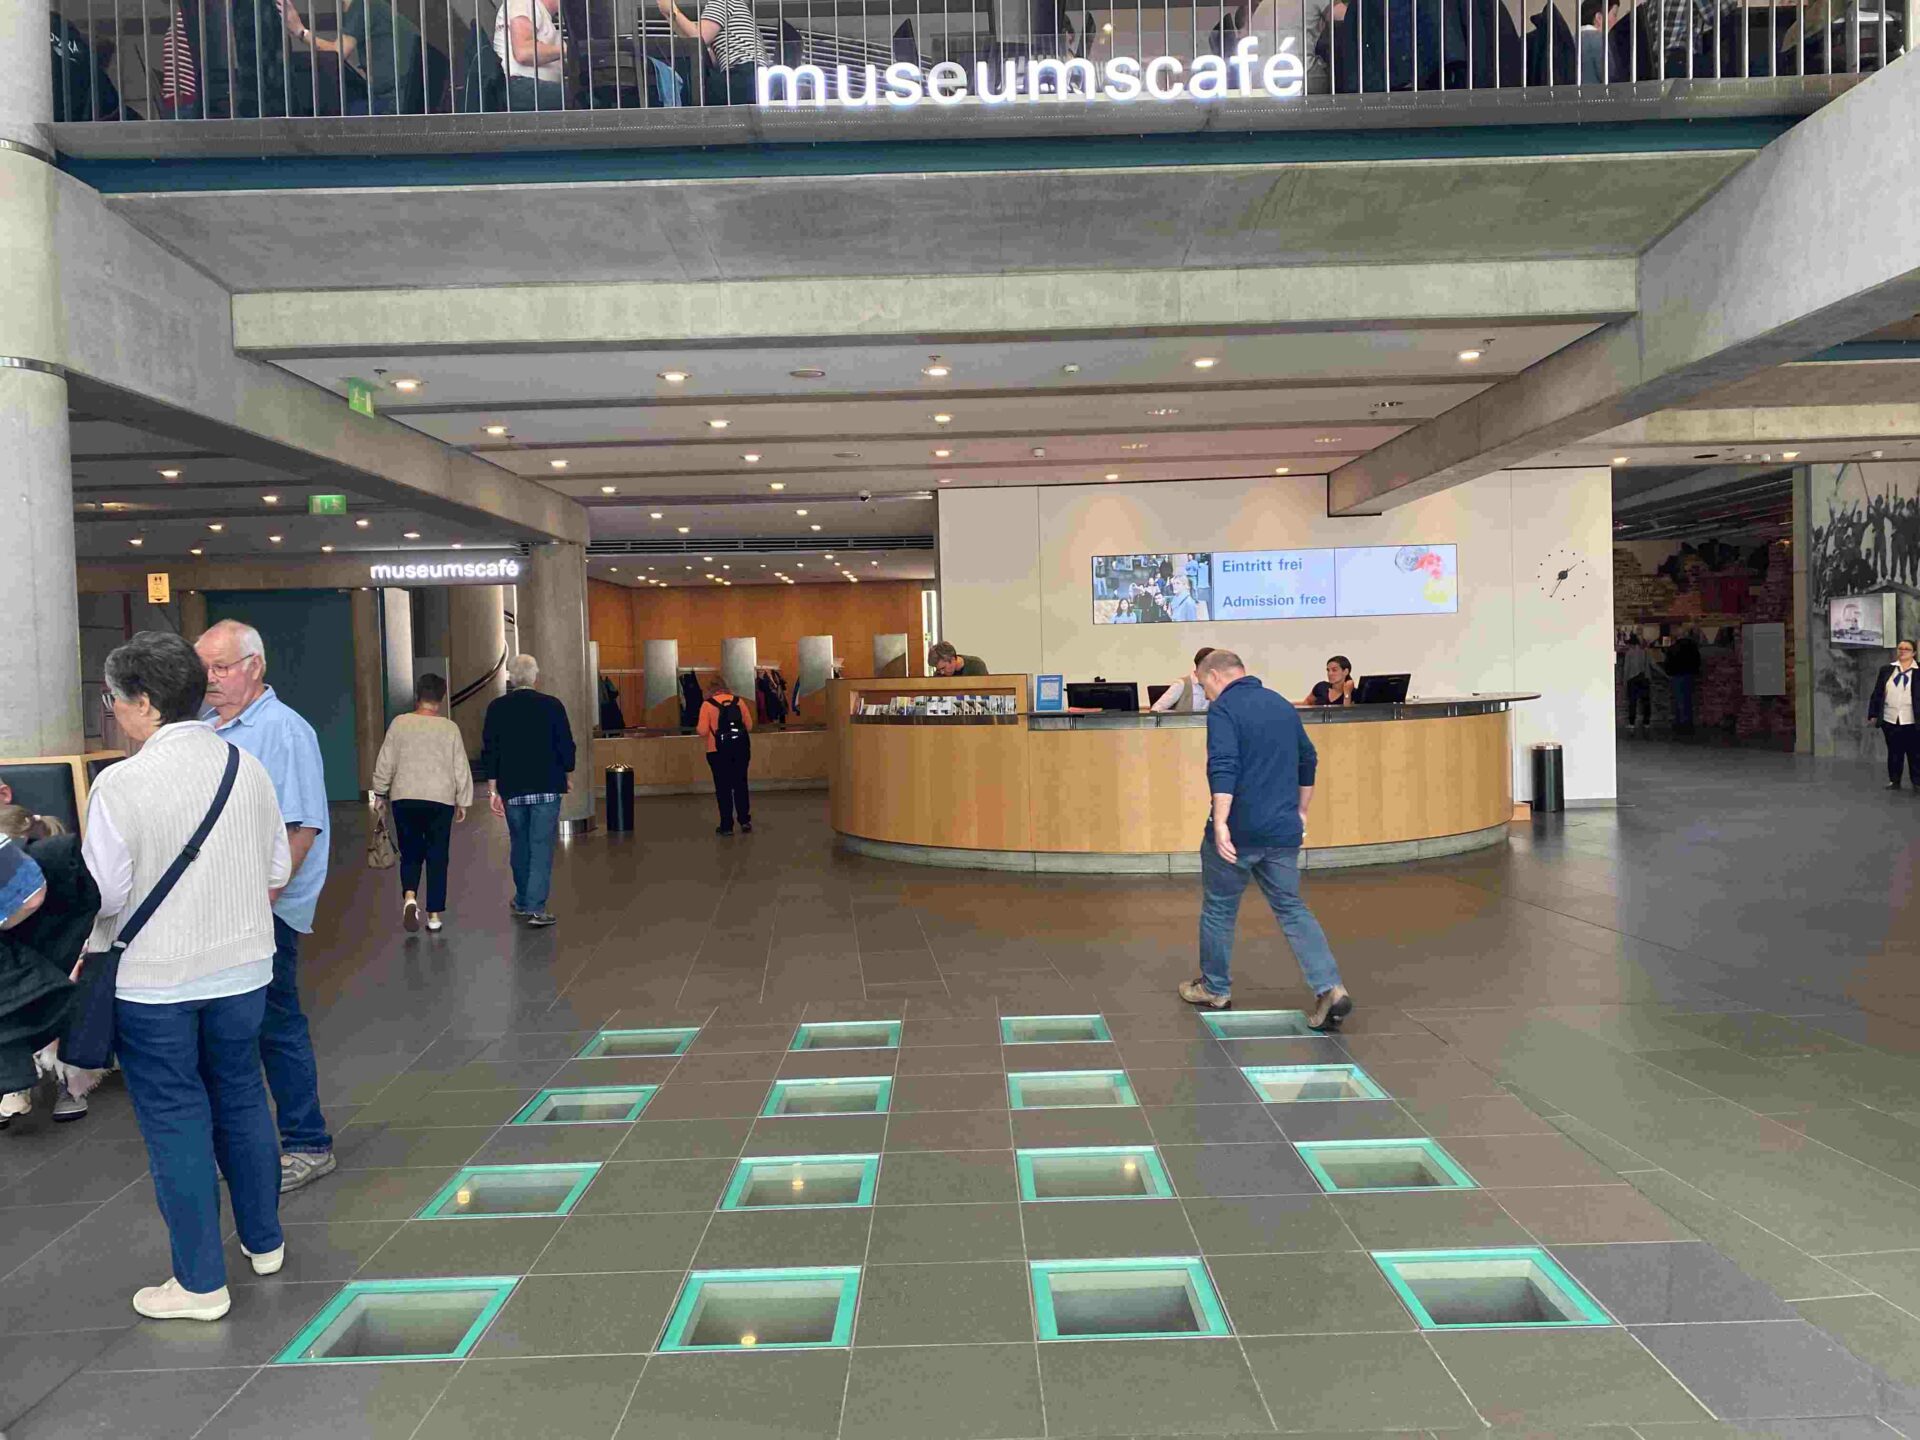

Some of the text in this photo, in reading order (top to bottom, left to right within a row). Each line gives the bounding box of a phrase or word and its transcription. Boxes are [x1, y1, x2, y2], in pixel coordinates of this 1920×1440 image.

[756, 36, 1306, 106] museumscafé
[370, 558, 519, 579] museumscafé
[1222, 557, 1303, 573] Eintritt frei
[1222, 593, 1327, 608] Admission free
